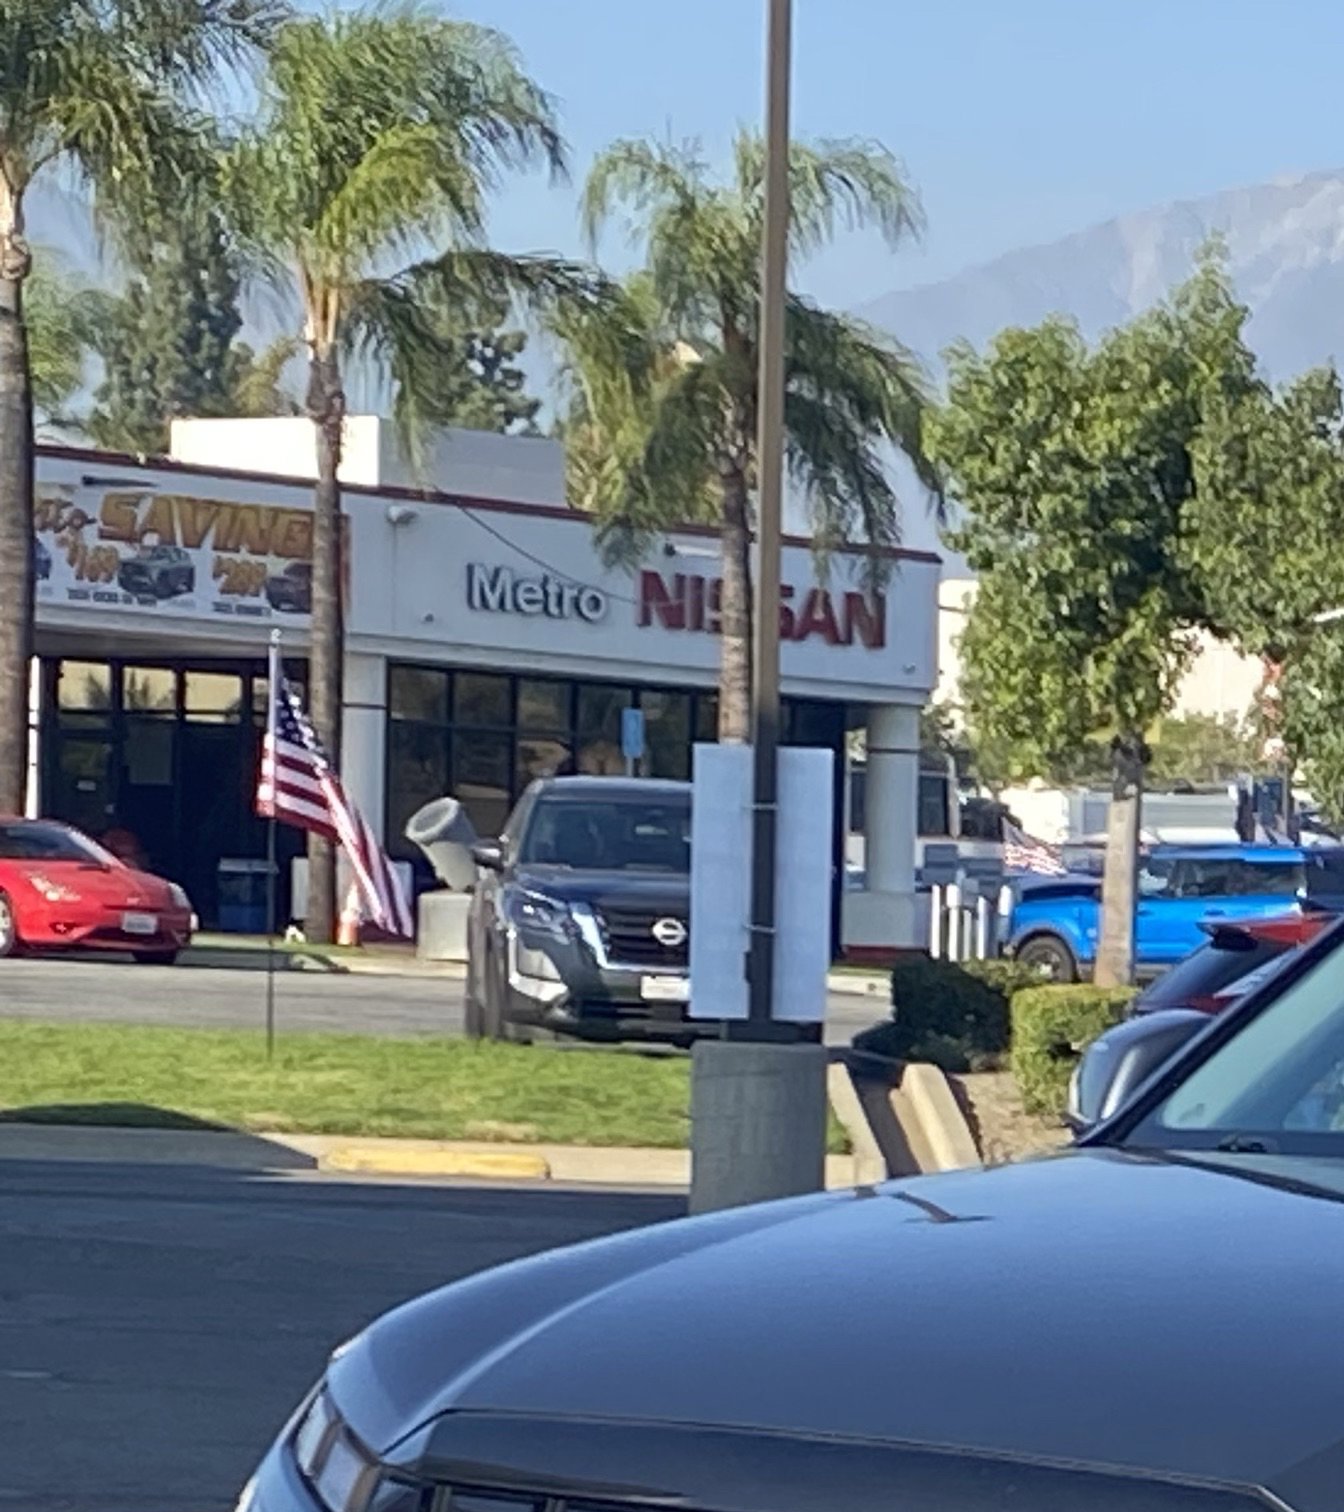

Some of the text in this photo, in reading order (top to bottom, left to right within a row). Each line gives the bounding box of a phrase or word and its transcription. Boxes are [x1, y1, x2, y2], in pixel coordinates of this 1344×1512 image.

[98, 489, 313, 563] SAVING
[466, 562, 887, 649] Metro NIAN
